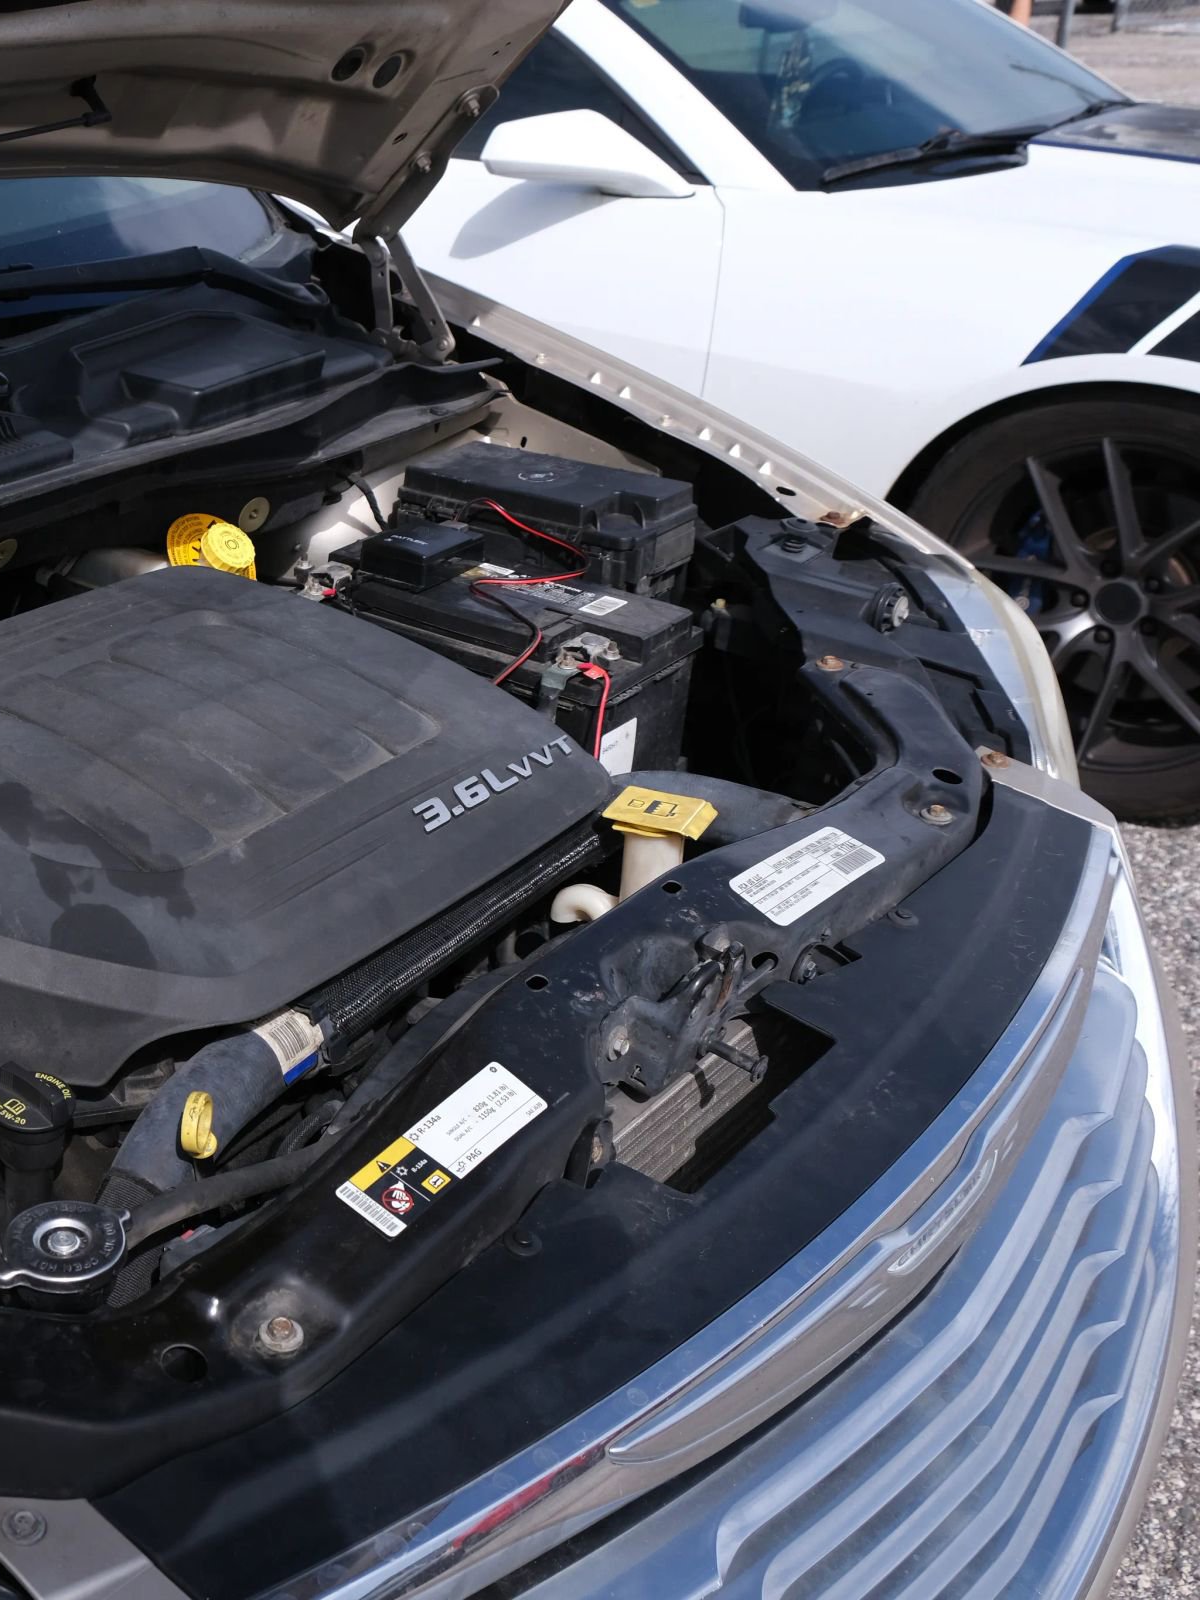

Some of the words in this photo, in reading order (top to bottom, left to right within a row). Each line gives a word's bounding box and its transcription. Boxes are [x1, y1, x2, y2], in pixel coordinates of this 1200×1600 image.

[35, 1072, 66, 1090] ENGINE
[62, 1088, 72, 1100] OIL
[473, 1101, 488, 1112] 820g
[478, 1107, 496, 1120] 1150g
[0, 1110, 26, 1125] 5W-20
[417, 1115, 442, 1135] R-134a
[466, 1148, 482, 1162] PAG
